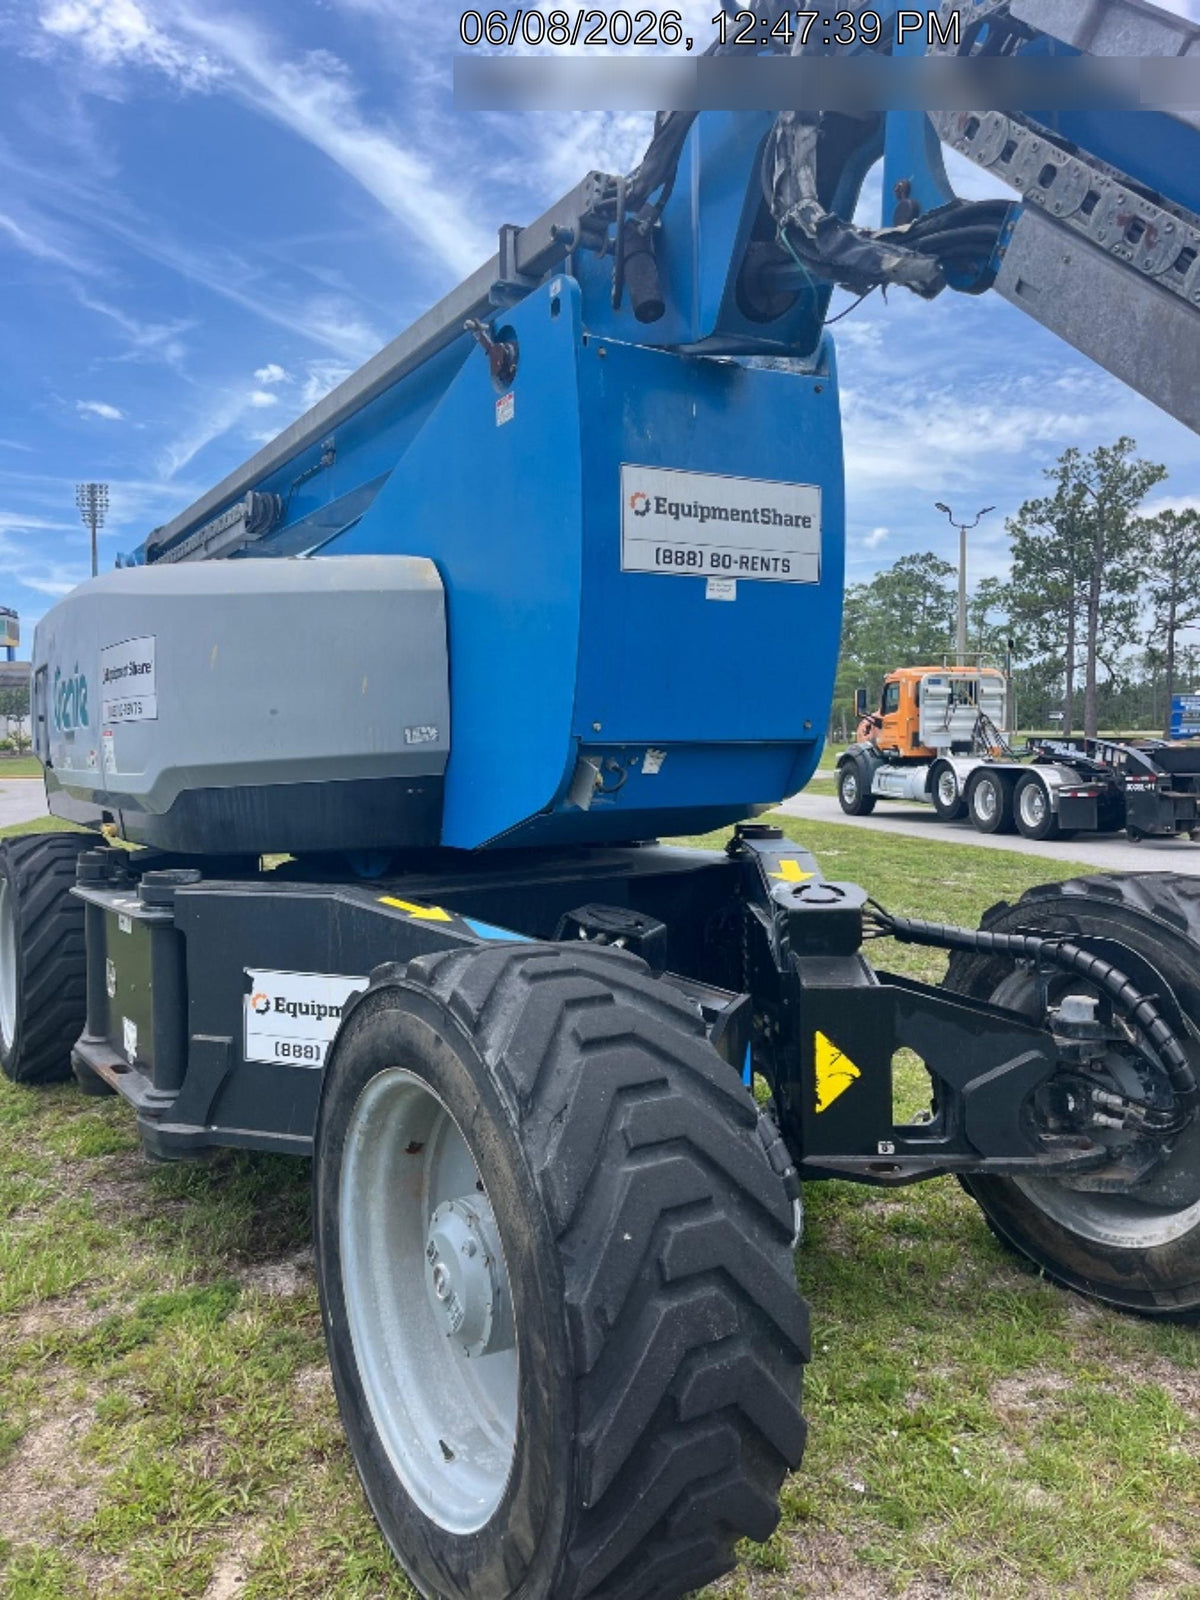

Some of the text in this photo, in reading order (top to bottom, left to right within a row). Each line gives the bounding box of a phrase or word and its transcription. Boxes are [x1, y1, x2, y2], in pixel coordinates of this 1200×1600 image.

[654, 496, 812, 529] EquipmentShare
[655, 547, 791, 574] (888) 80-RENTS
[275, 1041, 320, 1060] (888)
